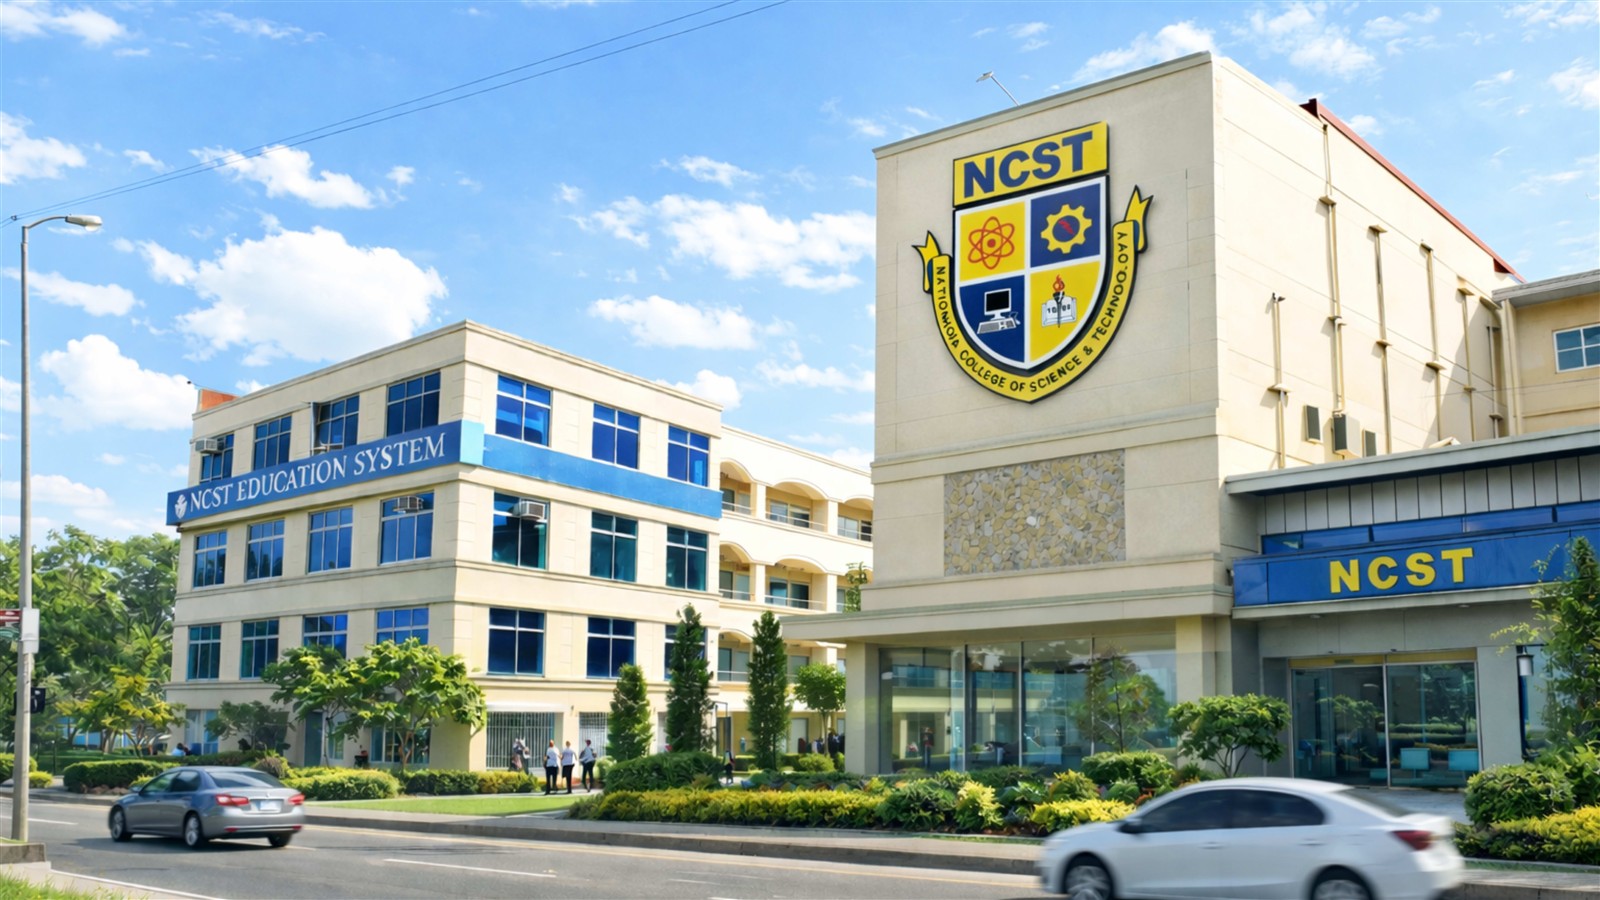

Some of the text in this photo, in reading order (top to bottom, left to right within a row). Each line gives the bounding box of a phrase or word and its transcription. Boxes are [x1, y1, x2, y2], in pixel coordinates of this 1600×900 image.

[964, 130, 1093, 199] NCST
[960, 350, 1006, 388] COLLEGE
[1009, 380, 1026, 392] OF
[1029, 355, 1082, 392] SCIENCE
[1083, 345, 1093, 356] &
[190, 433, 446, 513] NCST EDUCATION SYSTEM
[1329, 547, 1474, 594] NCST
